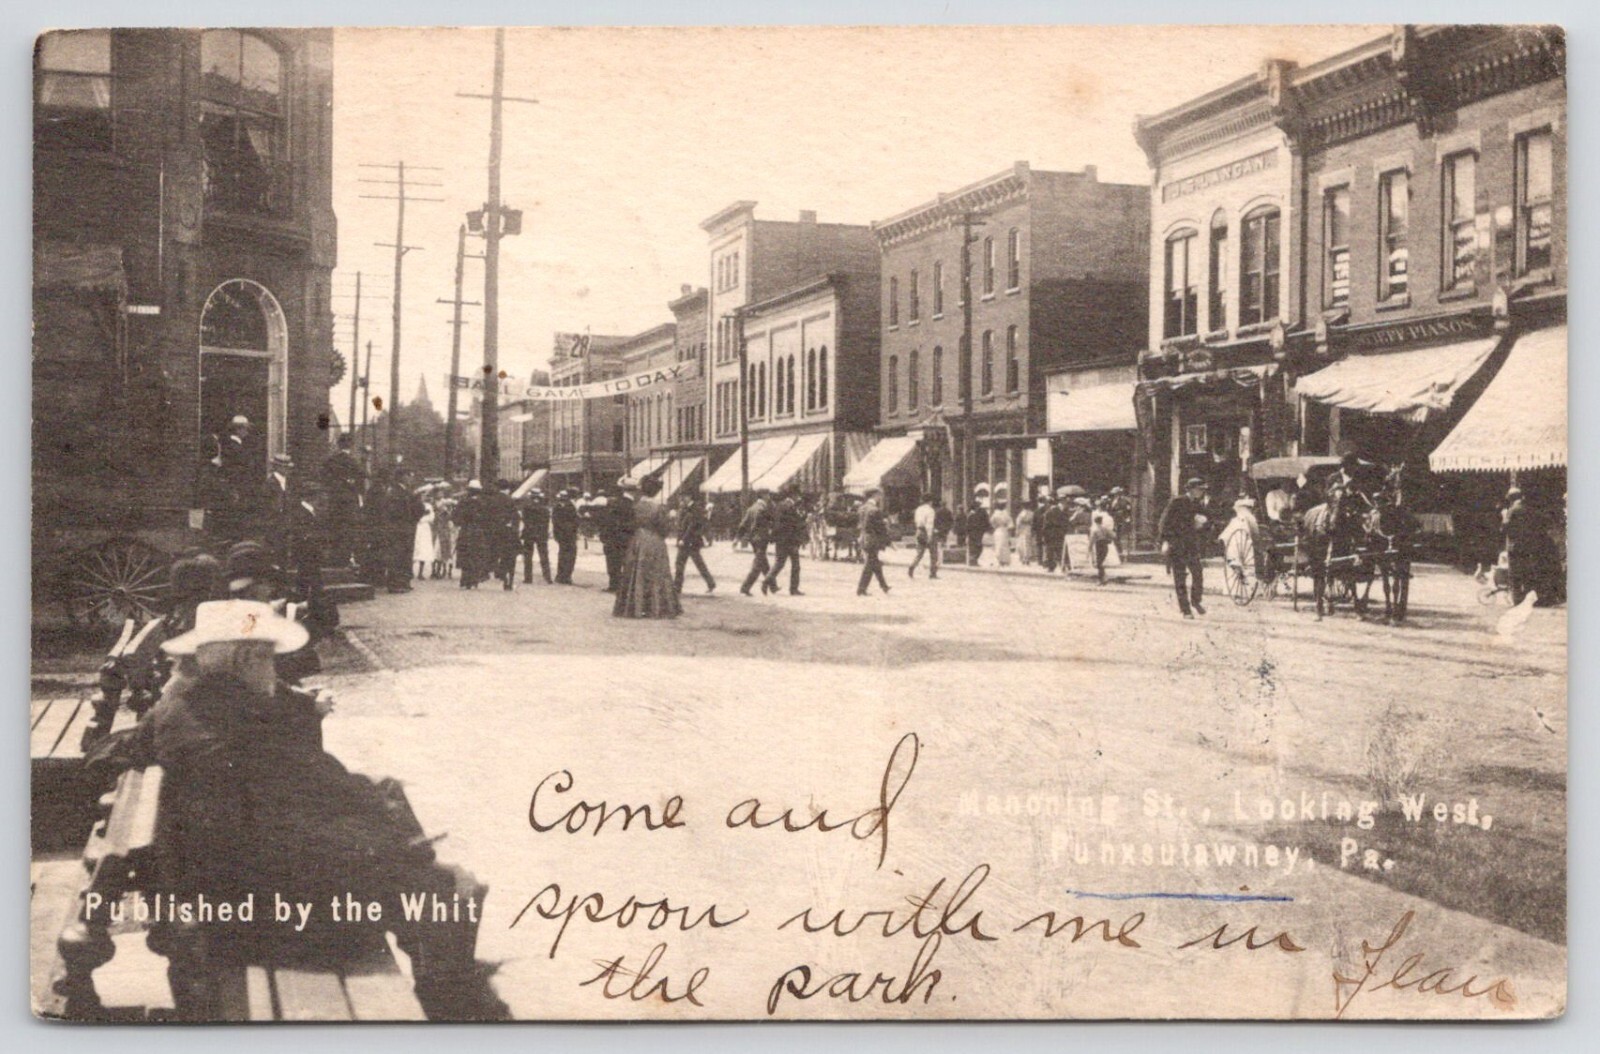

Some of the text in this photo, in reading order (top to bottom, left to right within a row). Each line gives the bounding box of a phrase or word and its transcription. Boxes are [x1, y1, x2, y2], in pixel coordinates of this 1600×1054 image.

[453, 375, 520, 396] BAL
[528, 732, 919, 870] Come and
[508, 883, 751, 960] spoon
[777, 862, 998, 941] with
[1012, 912, 1143, 948] me
[578, 930, 957, 1016] the park.
